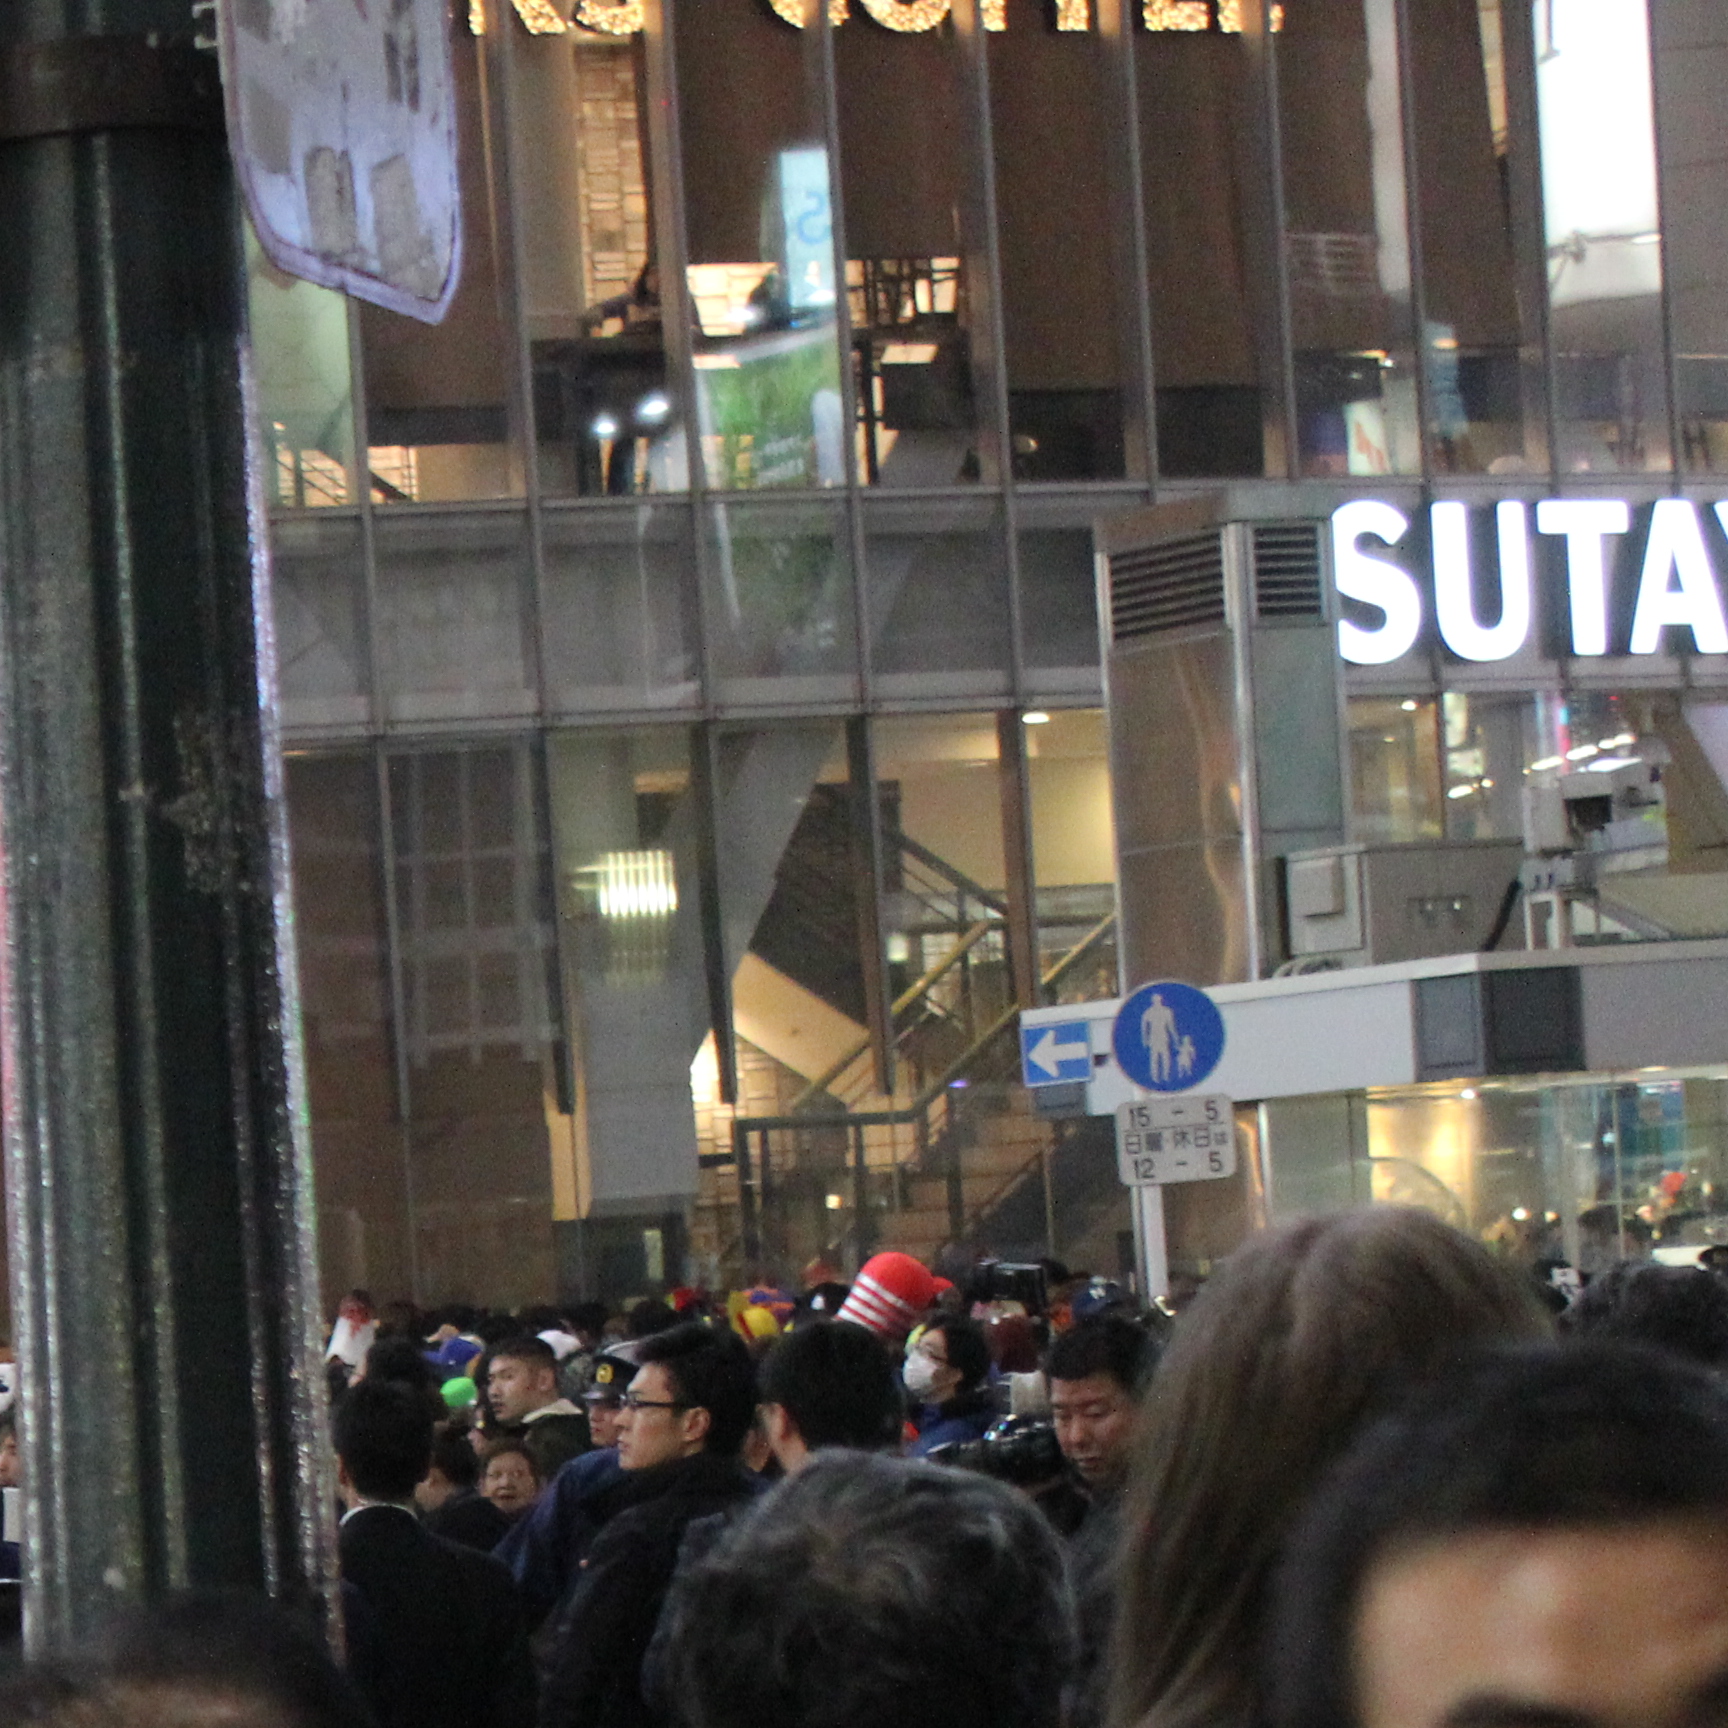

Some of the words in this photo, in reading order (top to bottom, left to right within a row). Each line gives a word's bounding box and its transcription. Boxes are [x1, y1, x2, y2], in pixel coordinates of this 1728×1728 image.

[1129, 1106, 1150, 1128] 15
[1205, 1099, 1218, 1121] 5
[1133, 1158, 1155, 1179] 12
[1209, 1151, 1223, 1173] 5
